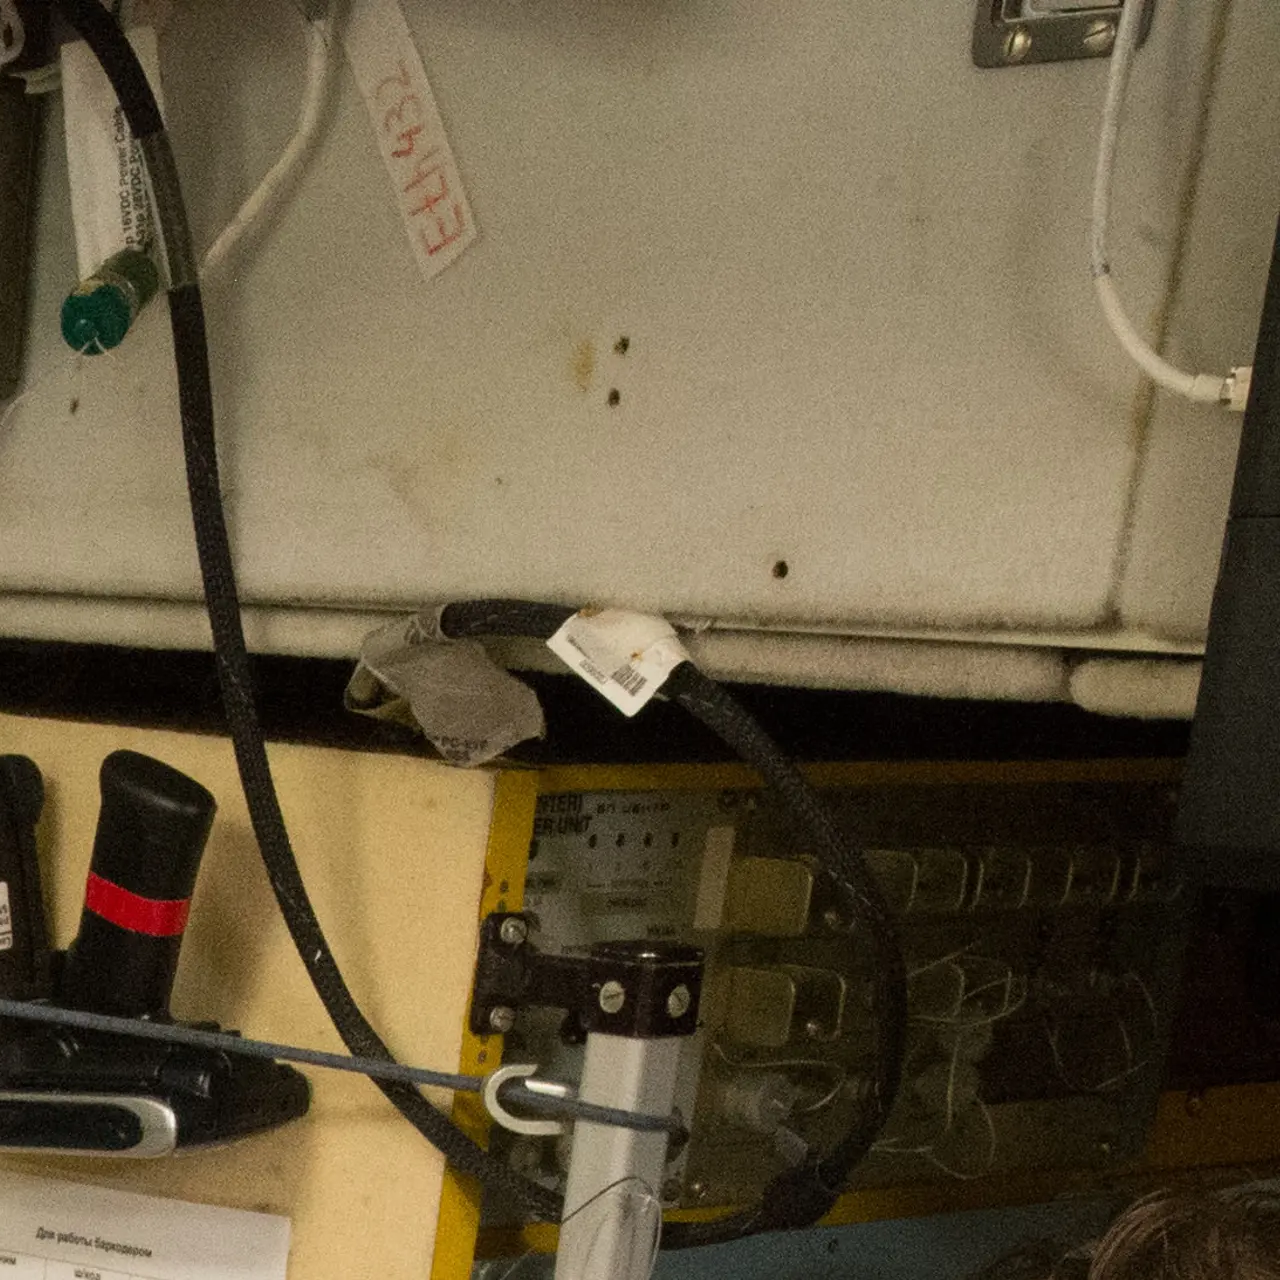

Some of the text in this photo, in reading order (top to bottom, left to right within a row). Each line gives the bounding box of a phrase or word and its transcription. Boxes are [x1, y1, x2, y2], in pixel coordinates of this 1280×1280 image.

[36, 1226, 153, 1258] Для работы баркодером
